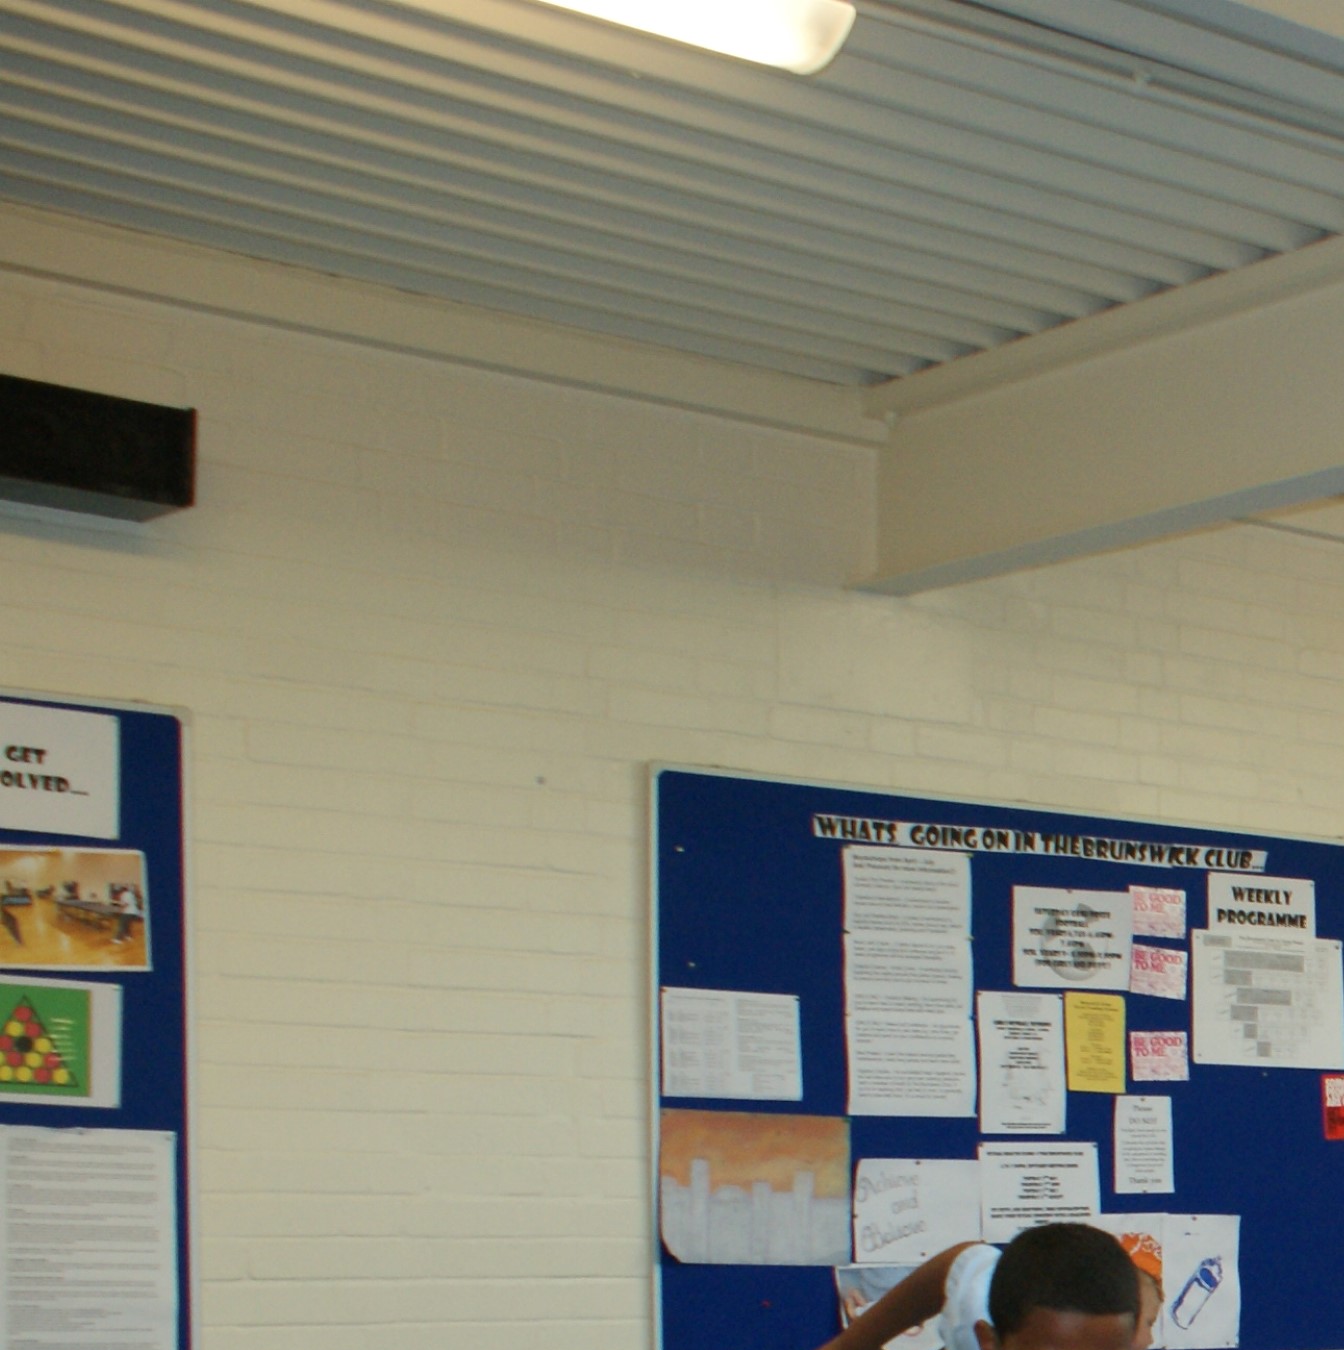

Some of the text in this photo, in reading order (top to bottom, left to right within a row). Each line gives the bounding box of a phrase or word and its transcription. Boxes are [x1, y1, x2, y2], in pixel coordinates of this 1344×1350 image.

[5, 745, 46, 765] GET
[815, 816, 898, 843] WHATS
[909, 825, 978, 849] GOING
[982, 830, 1011, 850] ON
[1014, 831, 1036, 852] IN
[1149, 893, 1181, 904] GOOD
[1231, 886, 1293, 905] WEEKLY
[1216, 908, 1307, 929] PROGRAMME
[1134, 960, 1148, 970] TO
[1150, 952, 1182, 965] GOOD
[1150, 1036, 1182, 1047] GOOD
[1135, 1046, 1149, 1057] TO
